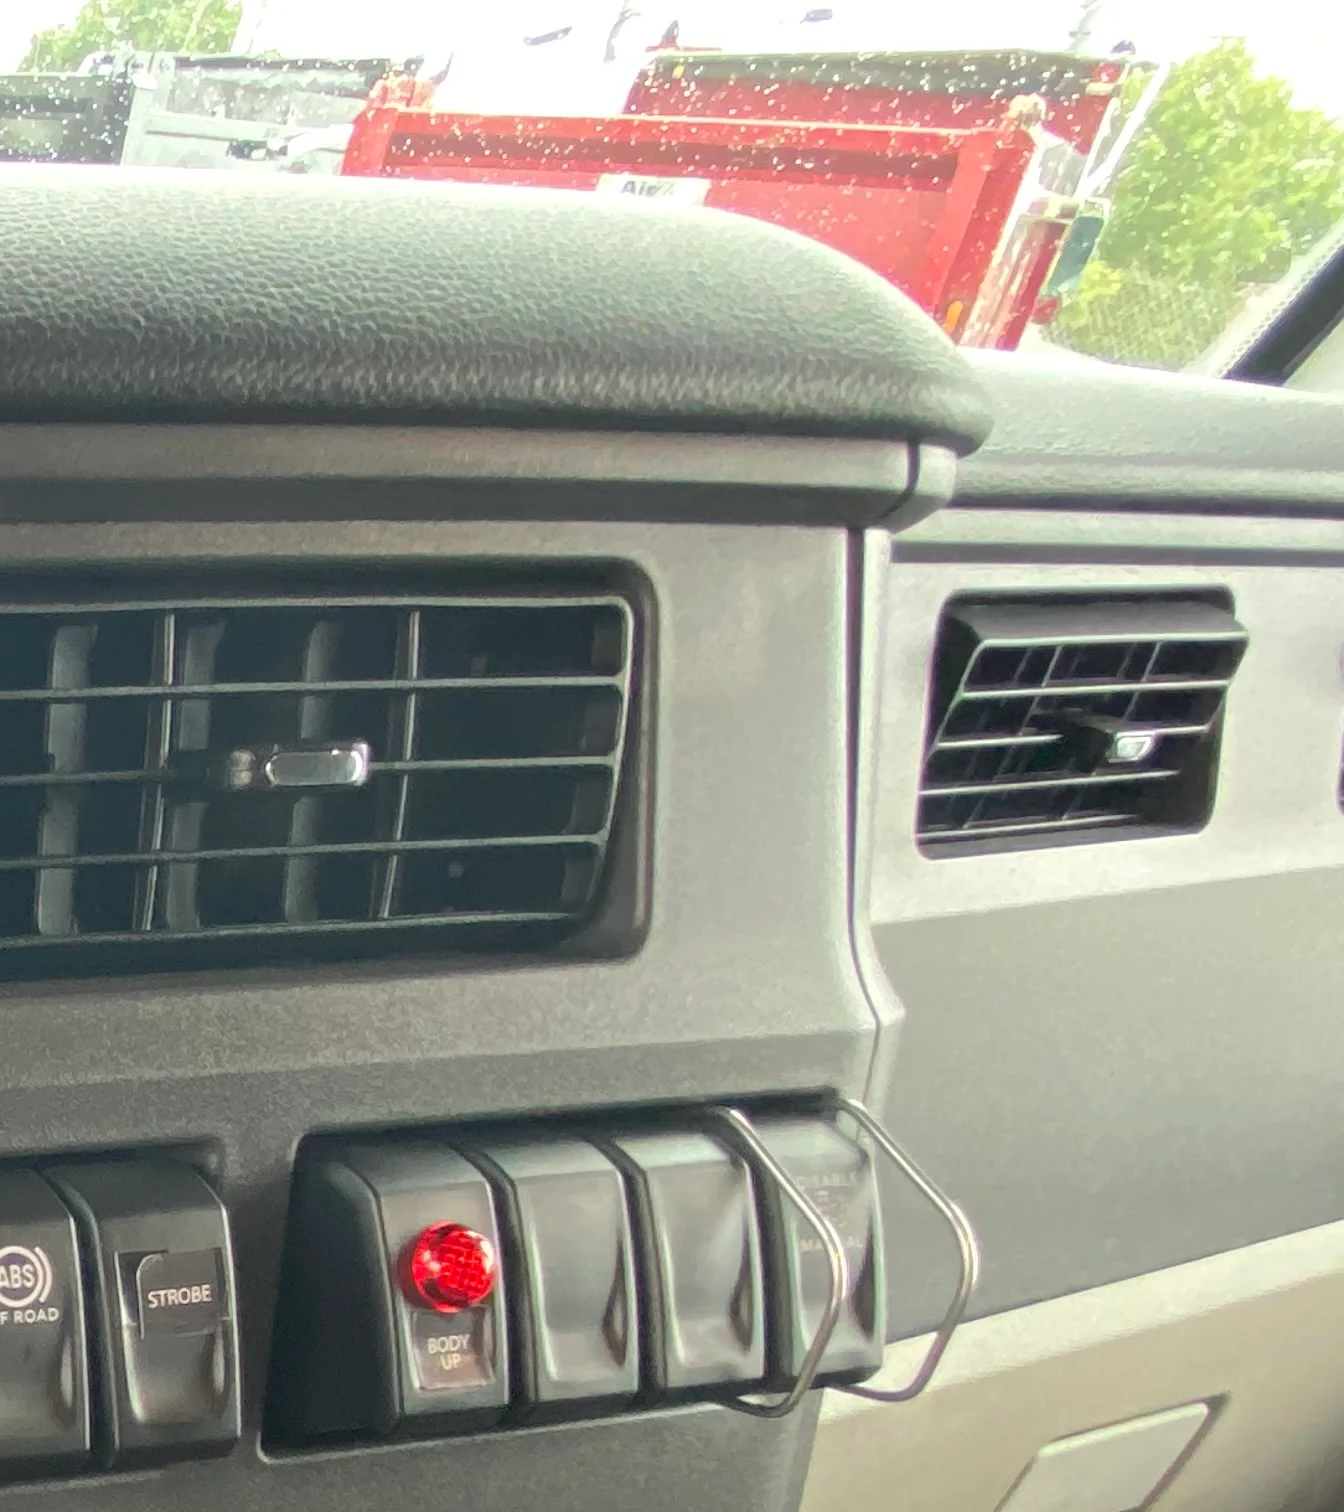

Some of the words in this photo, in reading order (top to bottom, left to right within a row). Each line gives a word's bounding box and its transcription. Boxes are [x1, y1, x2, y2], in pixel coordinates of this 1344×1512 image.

[147, 1284, 213, 1308] STROBE
[13, 1306, 60, 1324] ROAD
[427, 1333, 471, 1354] BODY
[439, 1352, 461, 1371] UP
